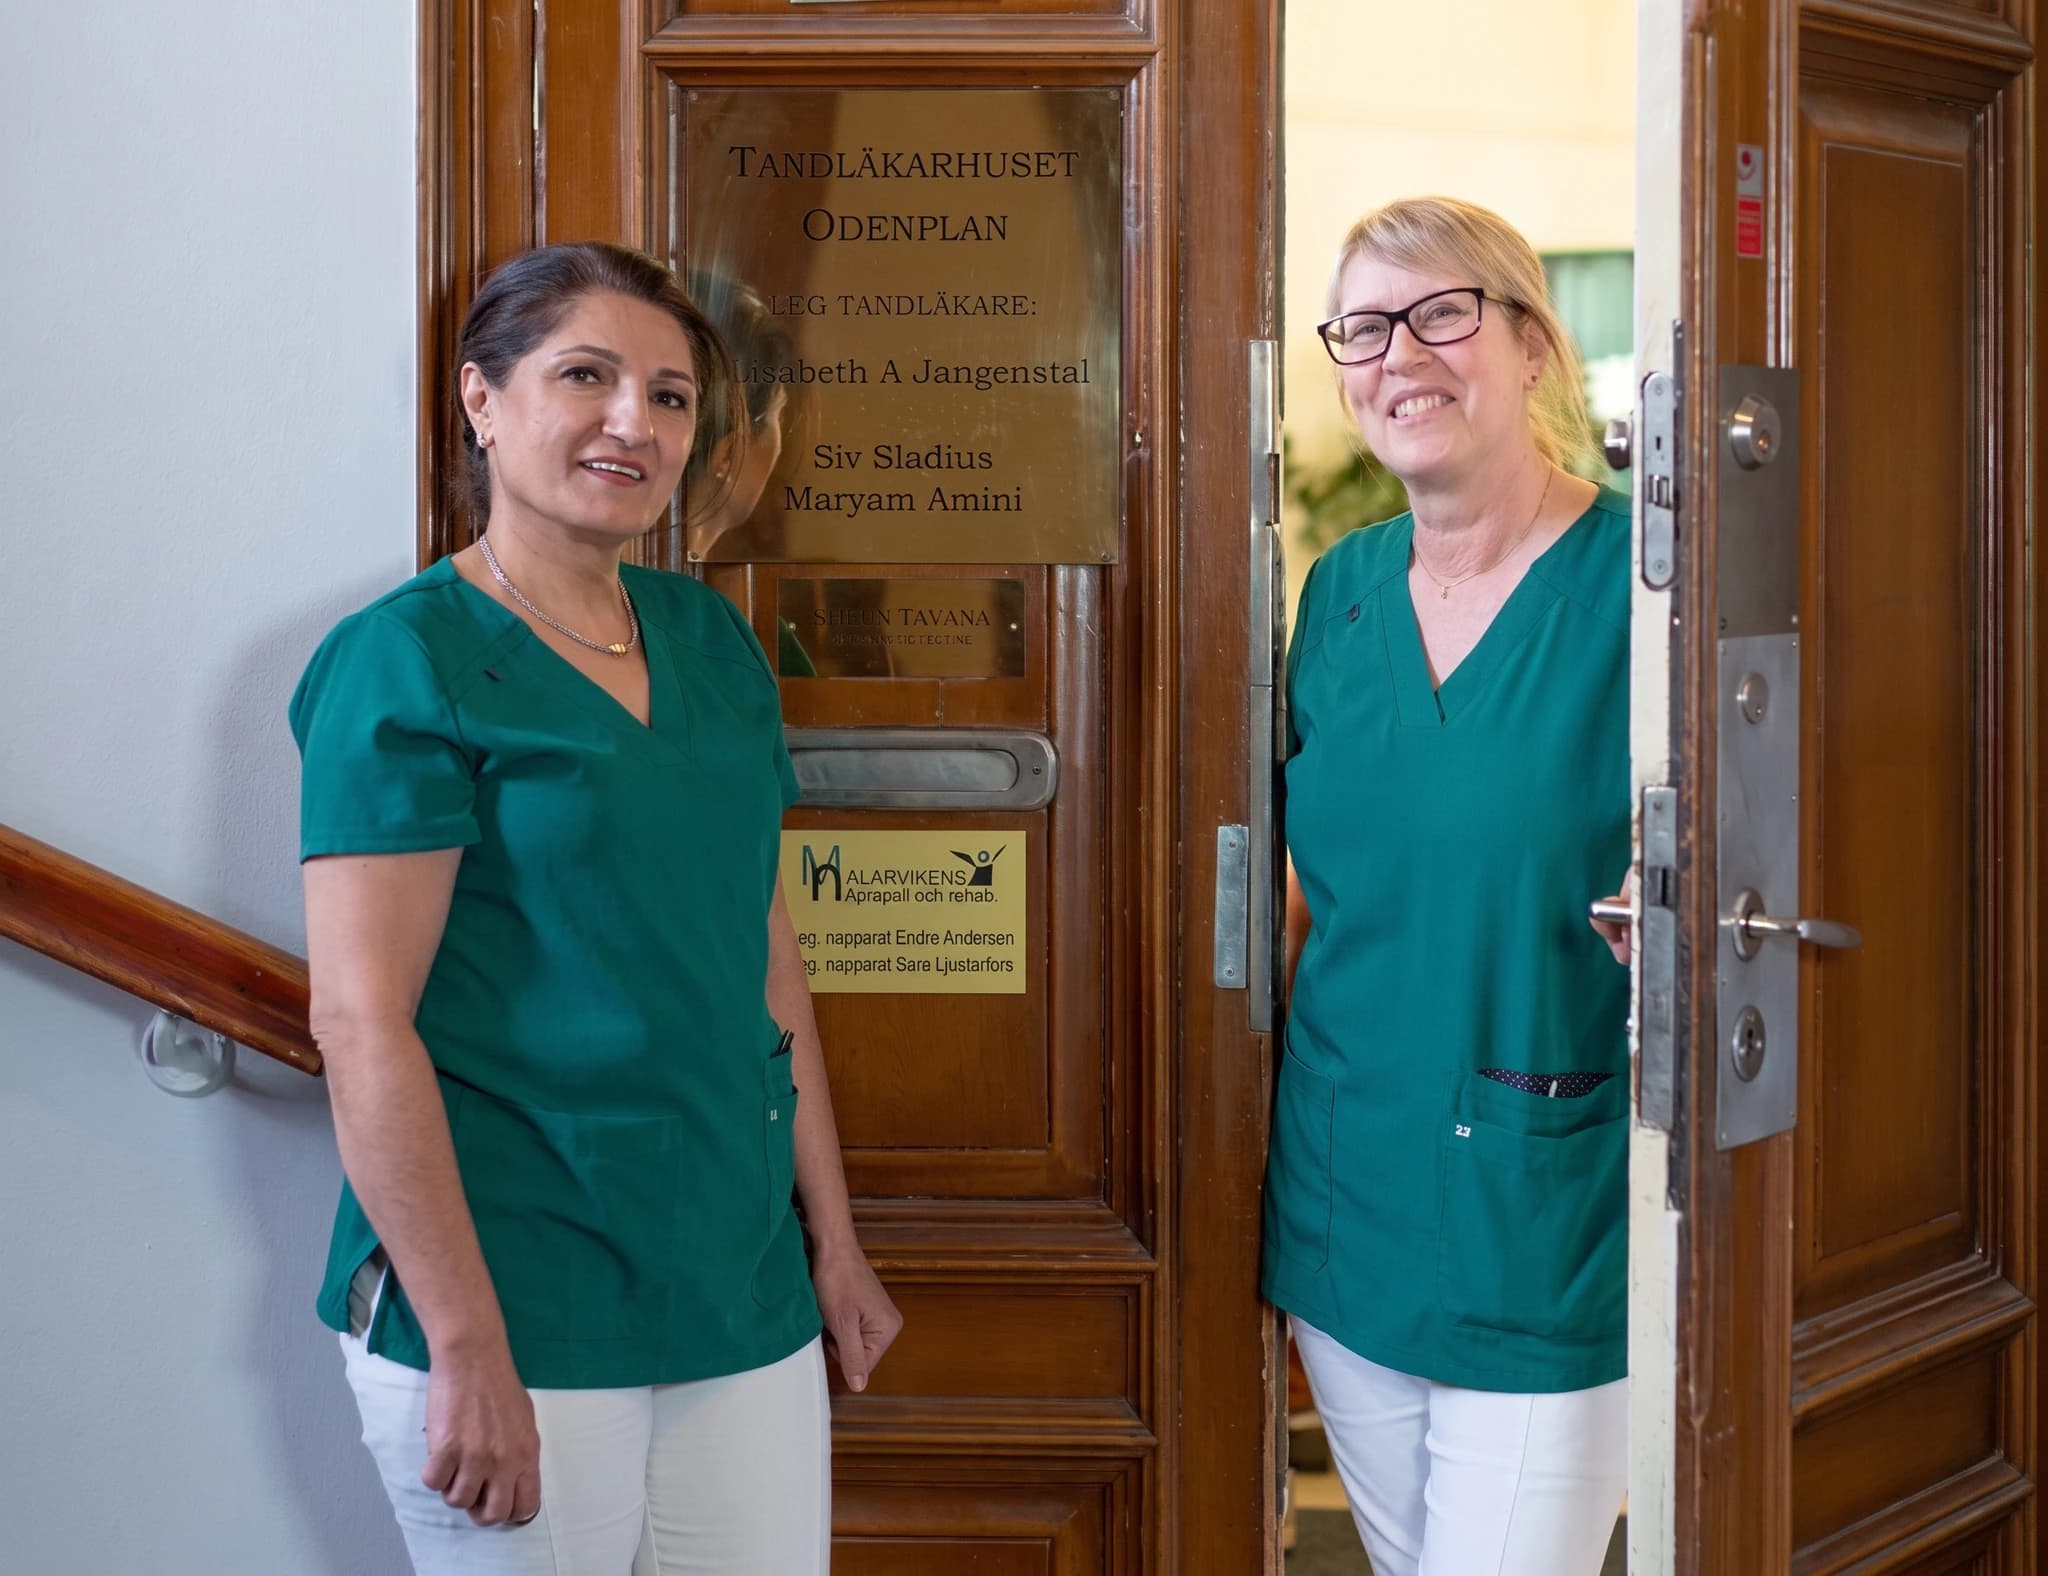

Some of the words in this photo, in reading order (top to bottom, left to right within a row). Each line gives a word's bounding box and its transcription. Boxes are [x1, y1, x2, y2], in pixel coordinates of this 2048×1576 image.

[729, 146, 1079, 178] TANDLÄKARHUSET
[803, 208, 1008, 241] ODENPLAN
[771, 296, 826, 316] LEG
[837, 291, 1037, 316] TANDLÄKARE:
[880, 359, 902, 384] A
[912, 359, 1090, 390] Jangenstal
[814, 444, 862, 469] Siv
[873, 444, 993, 469] Sladius
[784, 487, 916, 517] Maryam
[927, 487, 1023, 511] Amini
[898, 608, 991, 626] TAVANA
[914, 888, 943, 902] och
[949, 888, 998, 902] rehab.
[826, 930, 892, 949] napparat
[896, 929, 940, 945] Endre
[943, 929, 1014, 945] Andersen
[826, 957, 892, 975] napparat
[896, 956, 931, 972] Sare
[936, 956, 1014, 976] Ljustarfors
